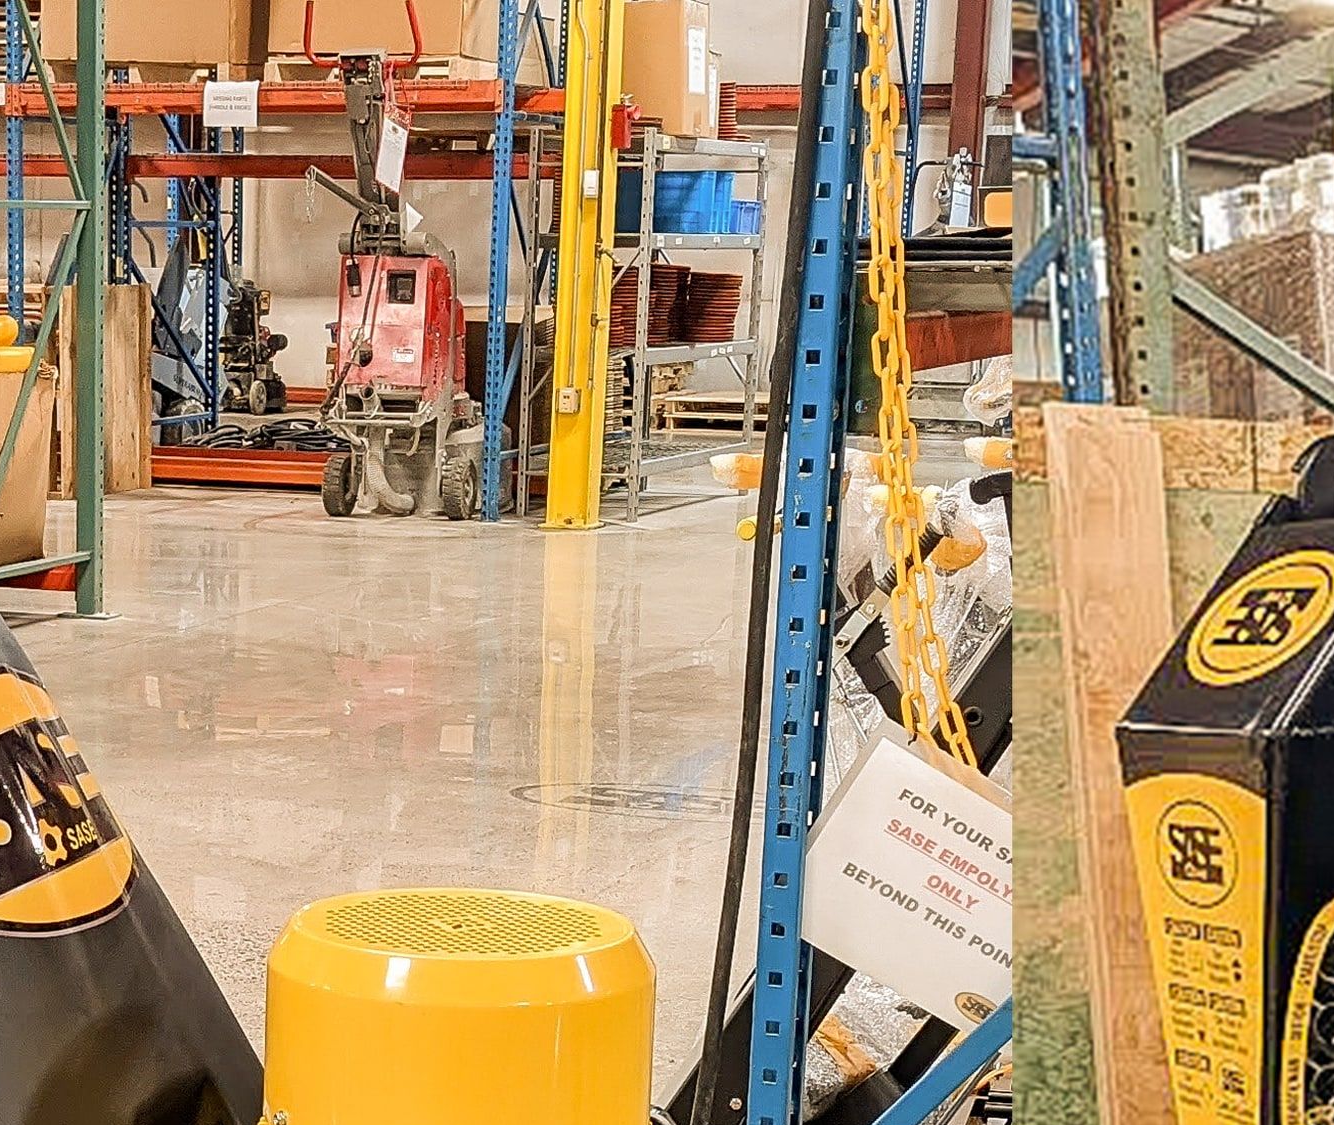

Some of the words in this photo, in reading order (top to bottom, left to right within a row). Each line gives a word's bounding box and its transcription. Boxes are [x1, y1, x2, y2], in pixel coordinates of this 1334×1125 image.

[886, 818, 938, 855] SASE
[898, 788, 938, 819] FOR
[941, 812, 994, 852] YOUR
[996, 846, 1012, 864] S
[841, 862, 919, 913] BEYOND
[925, 906, 967, 940] THIS
[927, 874, 980, 910] ONLY
